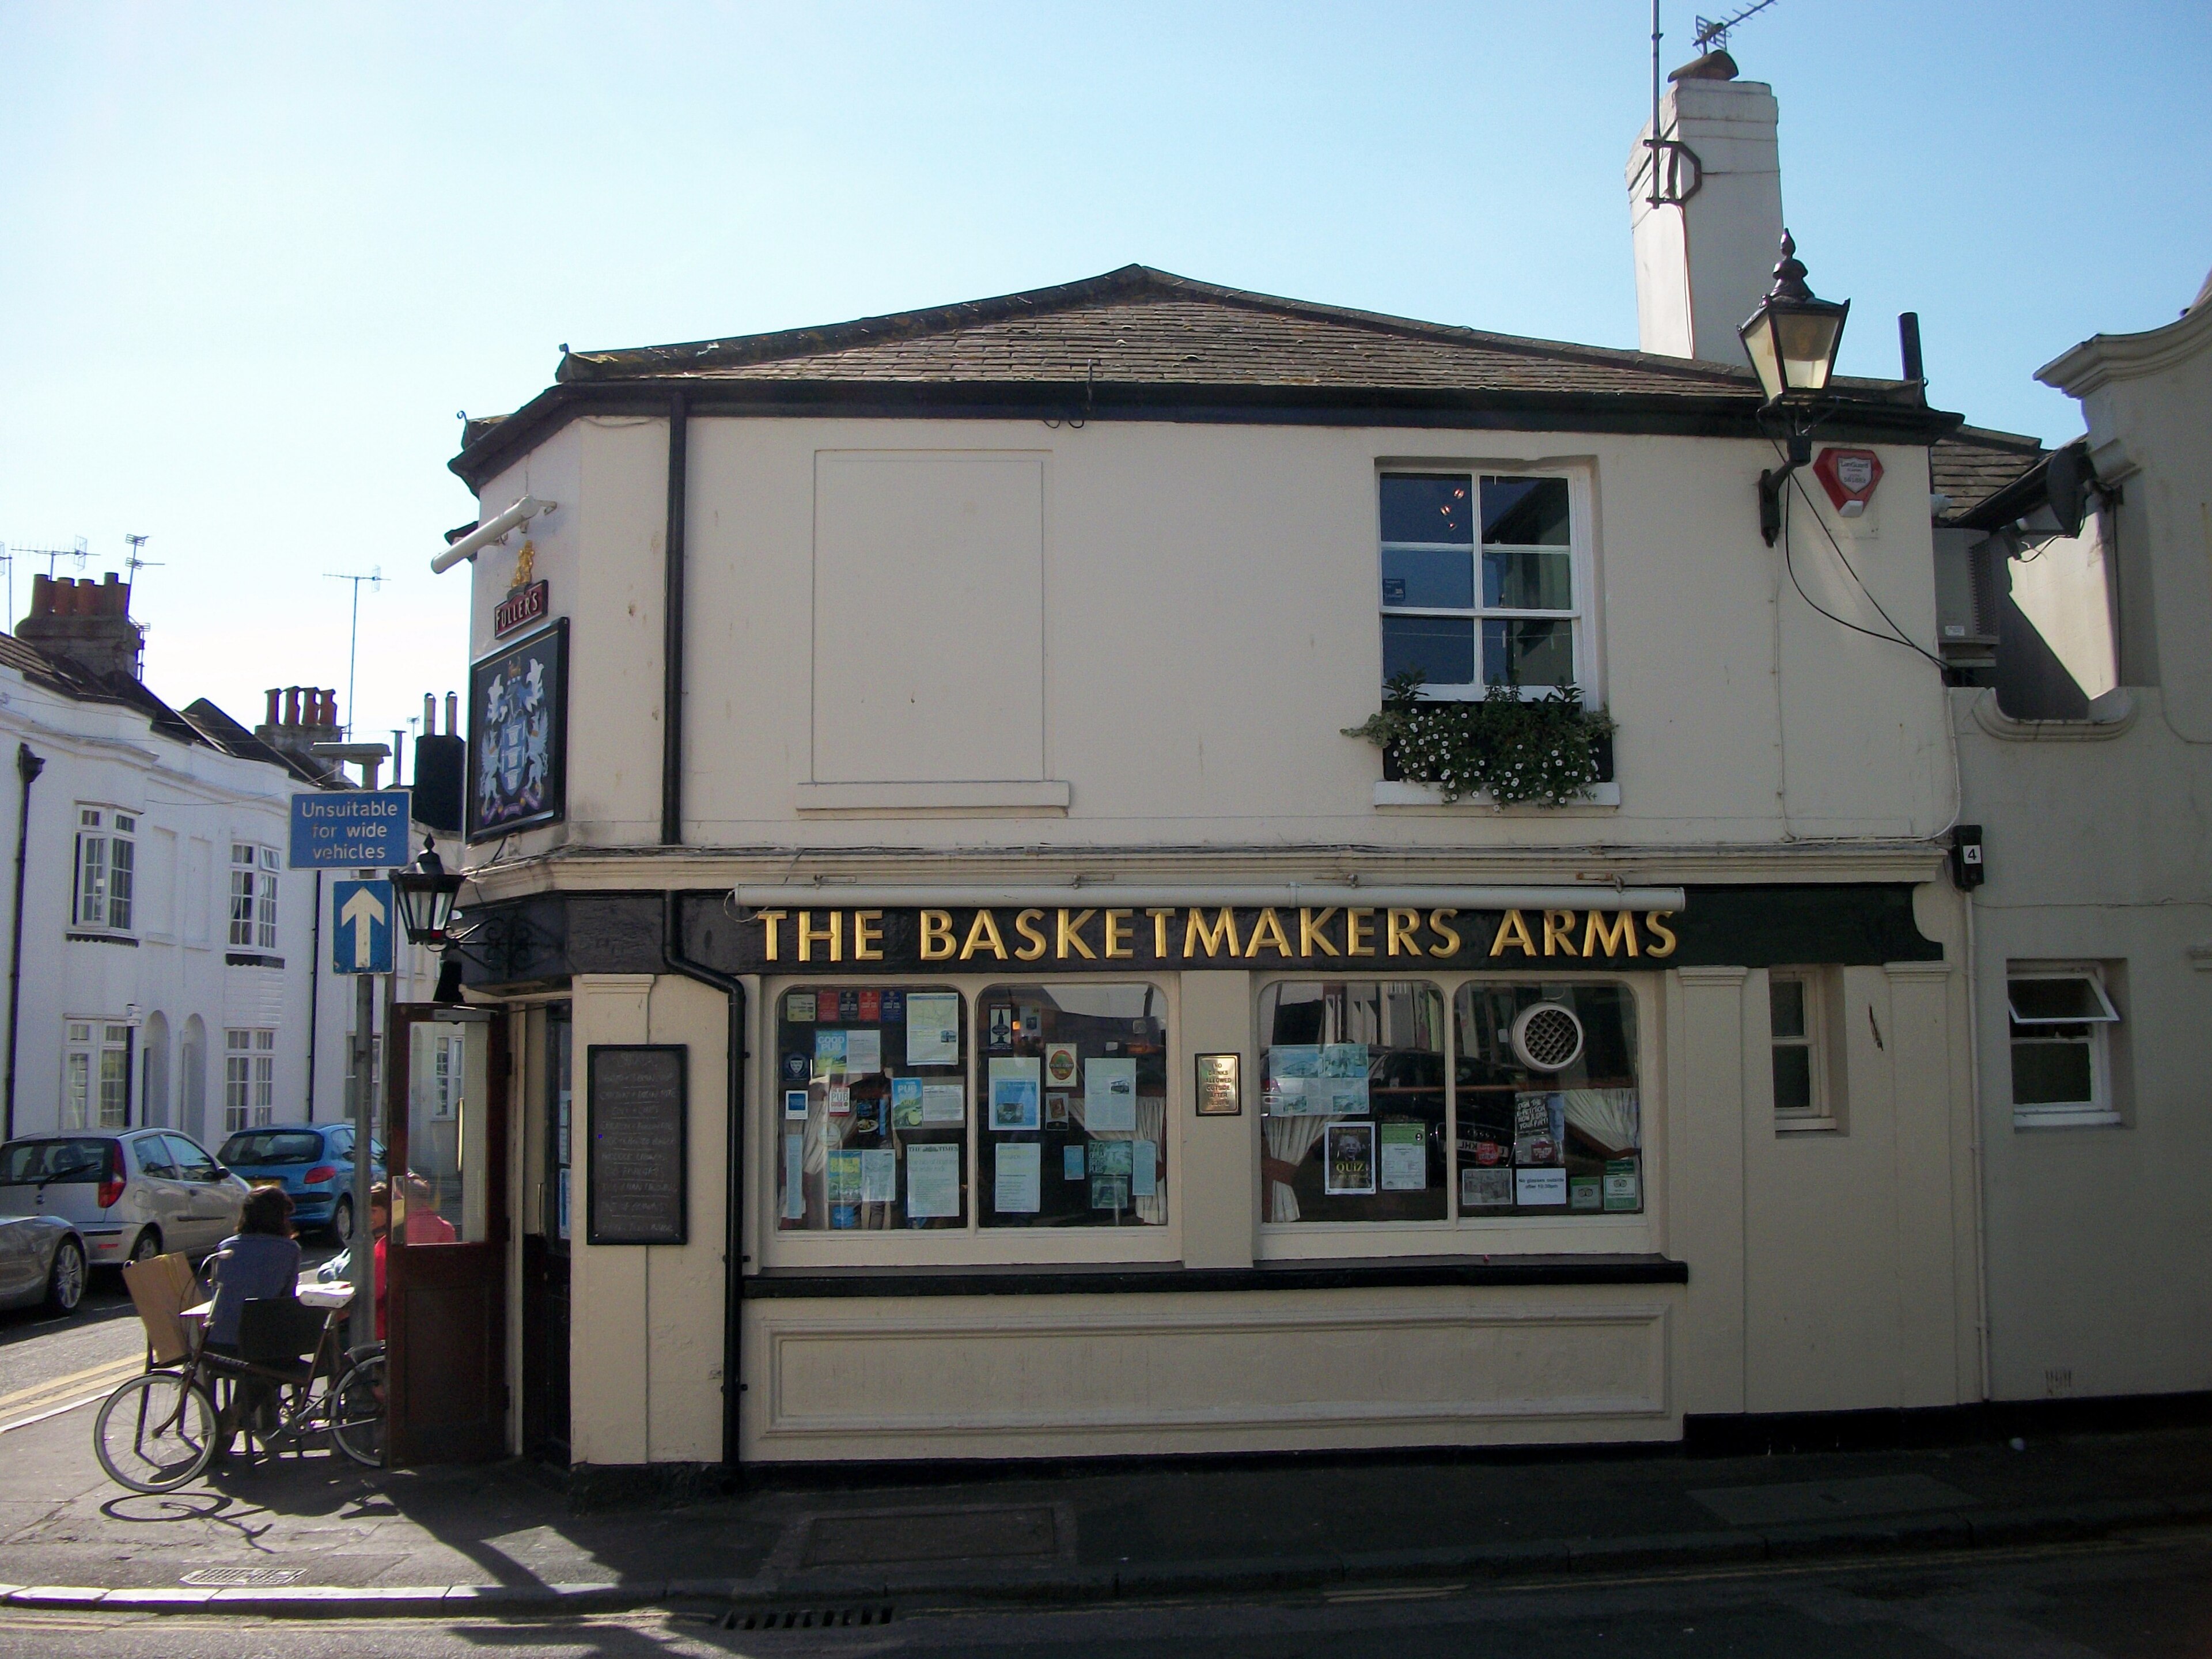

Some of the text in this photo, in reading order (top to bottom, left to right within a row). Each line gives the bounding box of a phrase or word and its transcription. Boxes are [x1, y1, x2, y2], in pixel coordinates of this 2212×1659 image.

[496, 591, 537, 631] FULLER'S
[302, 801, 397, 817] Unsuitable
[312, 822, 387, 839] for wide
[313, 843, 385, 859] vehicles
[1968, 849, 1976, 860] 4
[757, 907, 1677, 961] THE BASKETMAKERS ARMS
[831, 1093, 849, 1101] PUB
[897, 1085, 916, 1093] PUB
